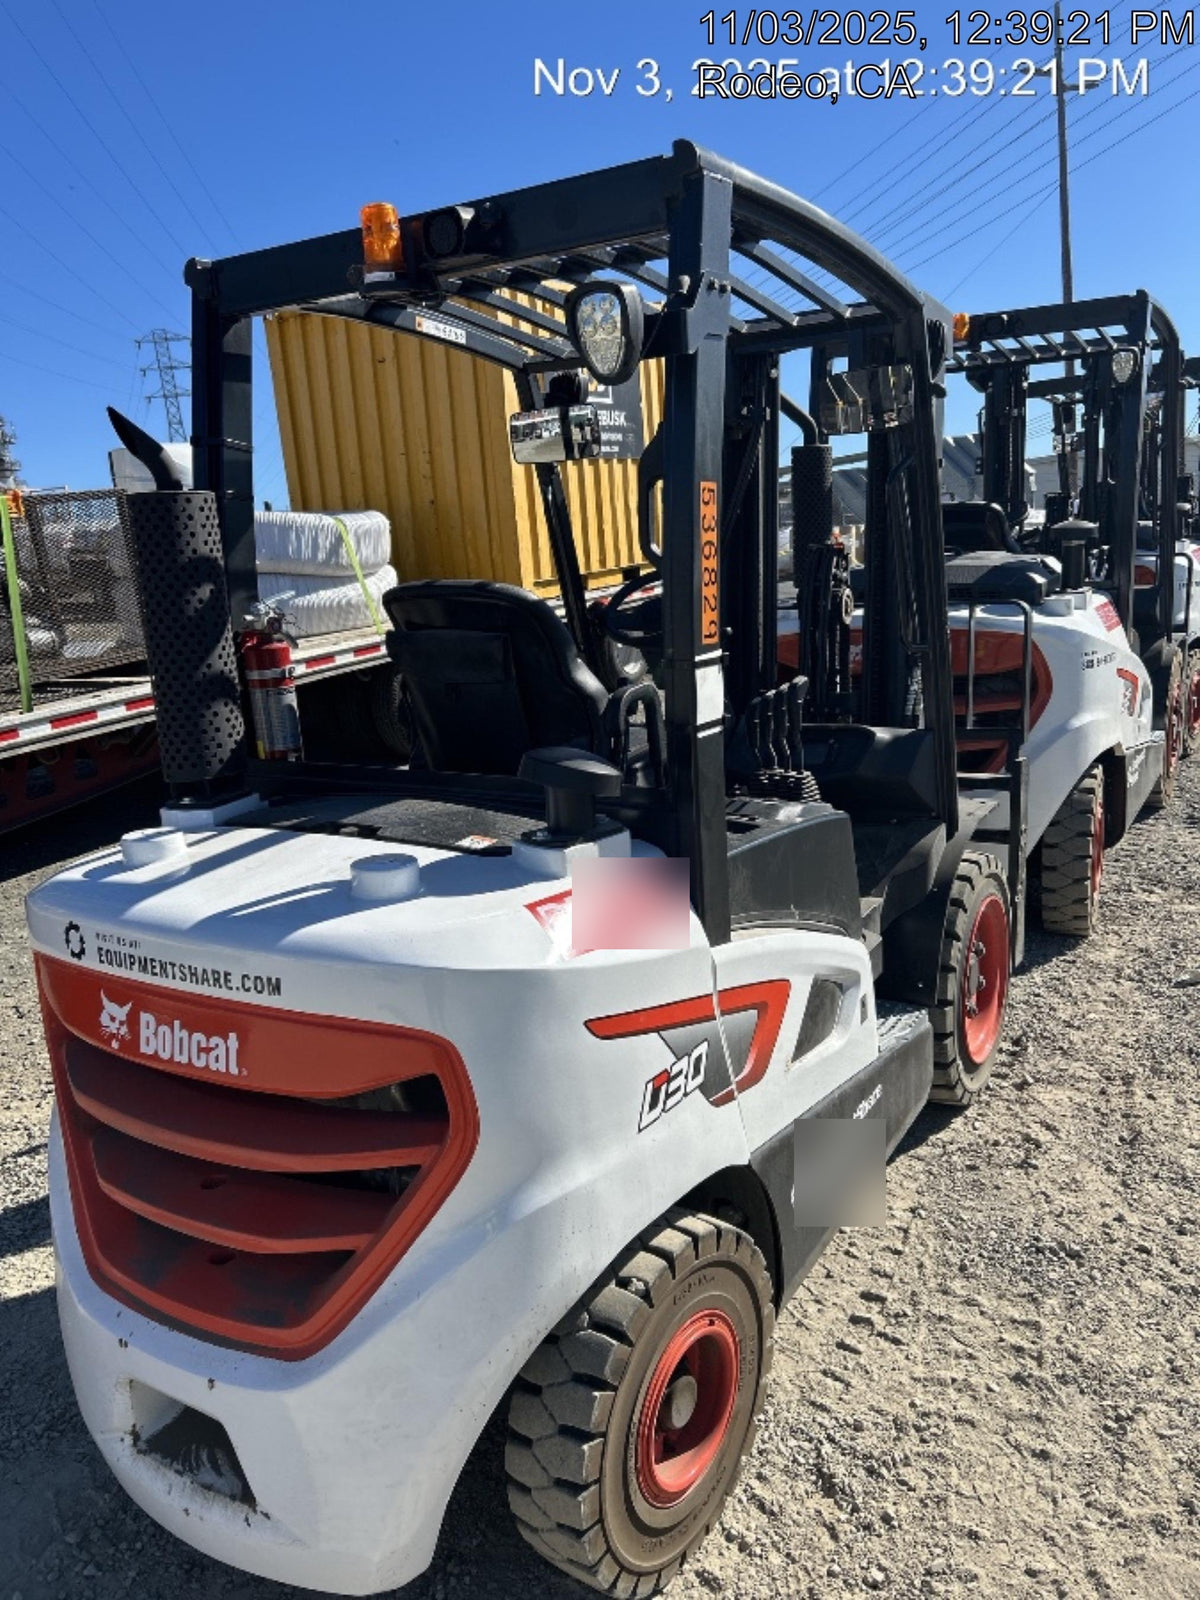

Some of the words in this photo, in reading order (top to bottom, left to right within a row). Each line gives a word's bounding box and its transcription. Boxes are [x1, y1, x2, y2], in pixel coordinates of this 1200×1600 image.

[702, 486, 718, 639] 536829
[97, 947, 282, 996] EQUIPMENTSHARE.COM
[140, 1012, 239, 1075] Bobcat
[637, 1037, 710, 1134] D30
